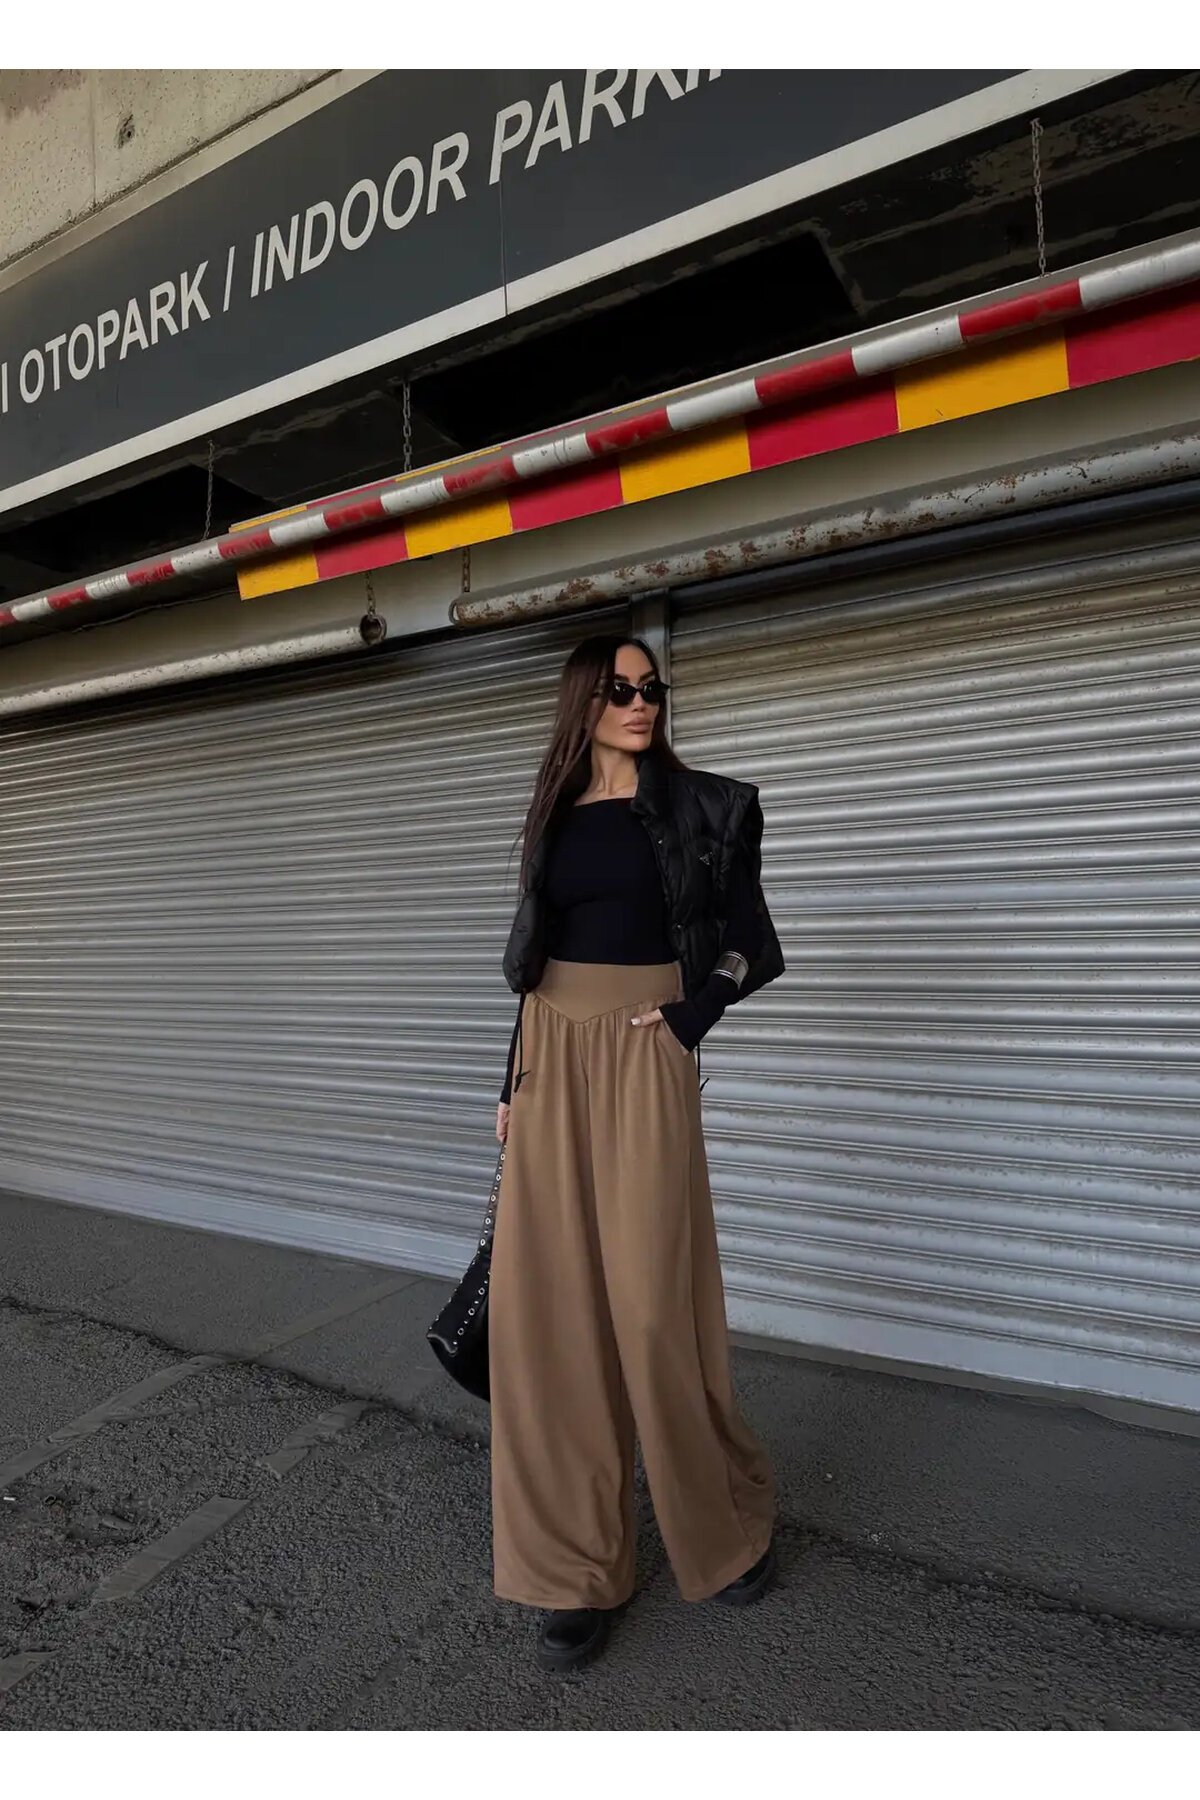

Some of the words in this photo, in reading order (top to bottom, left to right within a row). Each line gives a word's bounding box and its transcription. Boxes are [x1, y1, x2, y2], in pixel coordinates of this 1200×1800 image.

[20, 260, 211, 403] OTOPARK
[223, 246, 236, 312] /
[251, 132, 469, 298] INDOOR
[489, 69, 722, 185] PARK
